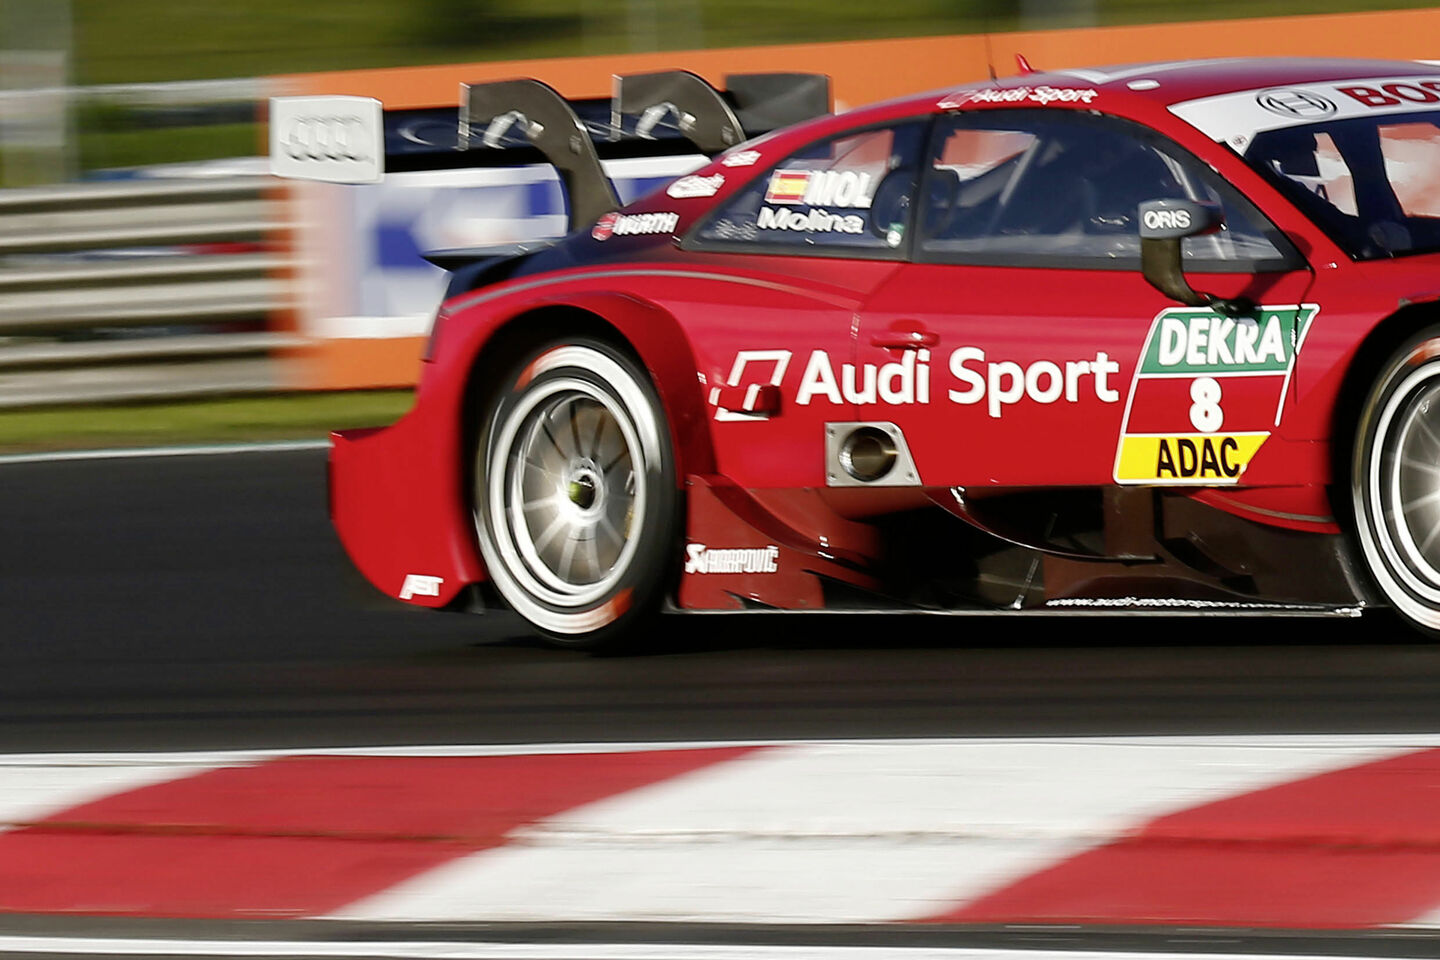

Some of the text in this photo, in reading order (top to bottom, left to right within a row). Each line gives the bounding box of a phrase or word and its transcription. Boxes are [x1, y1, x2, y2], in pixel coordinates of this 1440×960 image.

[970, 85, 1098, 105] Audi Sport
[803, 171, 872, 208] MOL
[757, 207, 864, 234] Molina
[1144, 209, 1191, 229] ORIS
[1158, 315, 1287, 366] DEKRA
[795, 346, 1119, 418] Audi Sport
[1189, 377, 1224, 433] 8
[1156, 437, 1240, 478] ADAC
